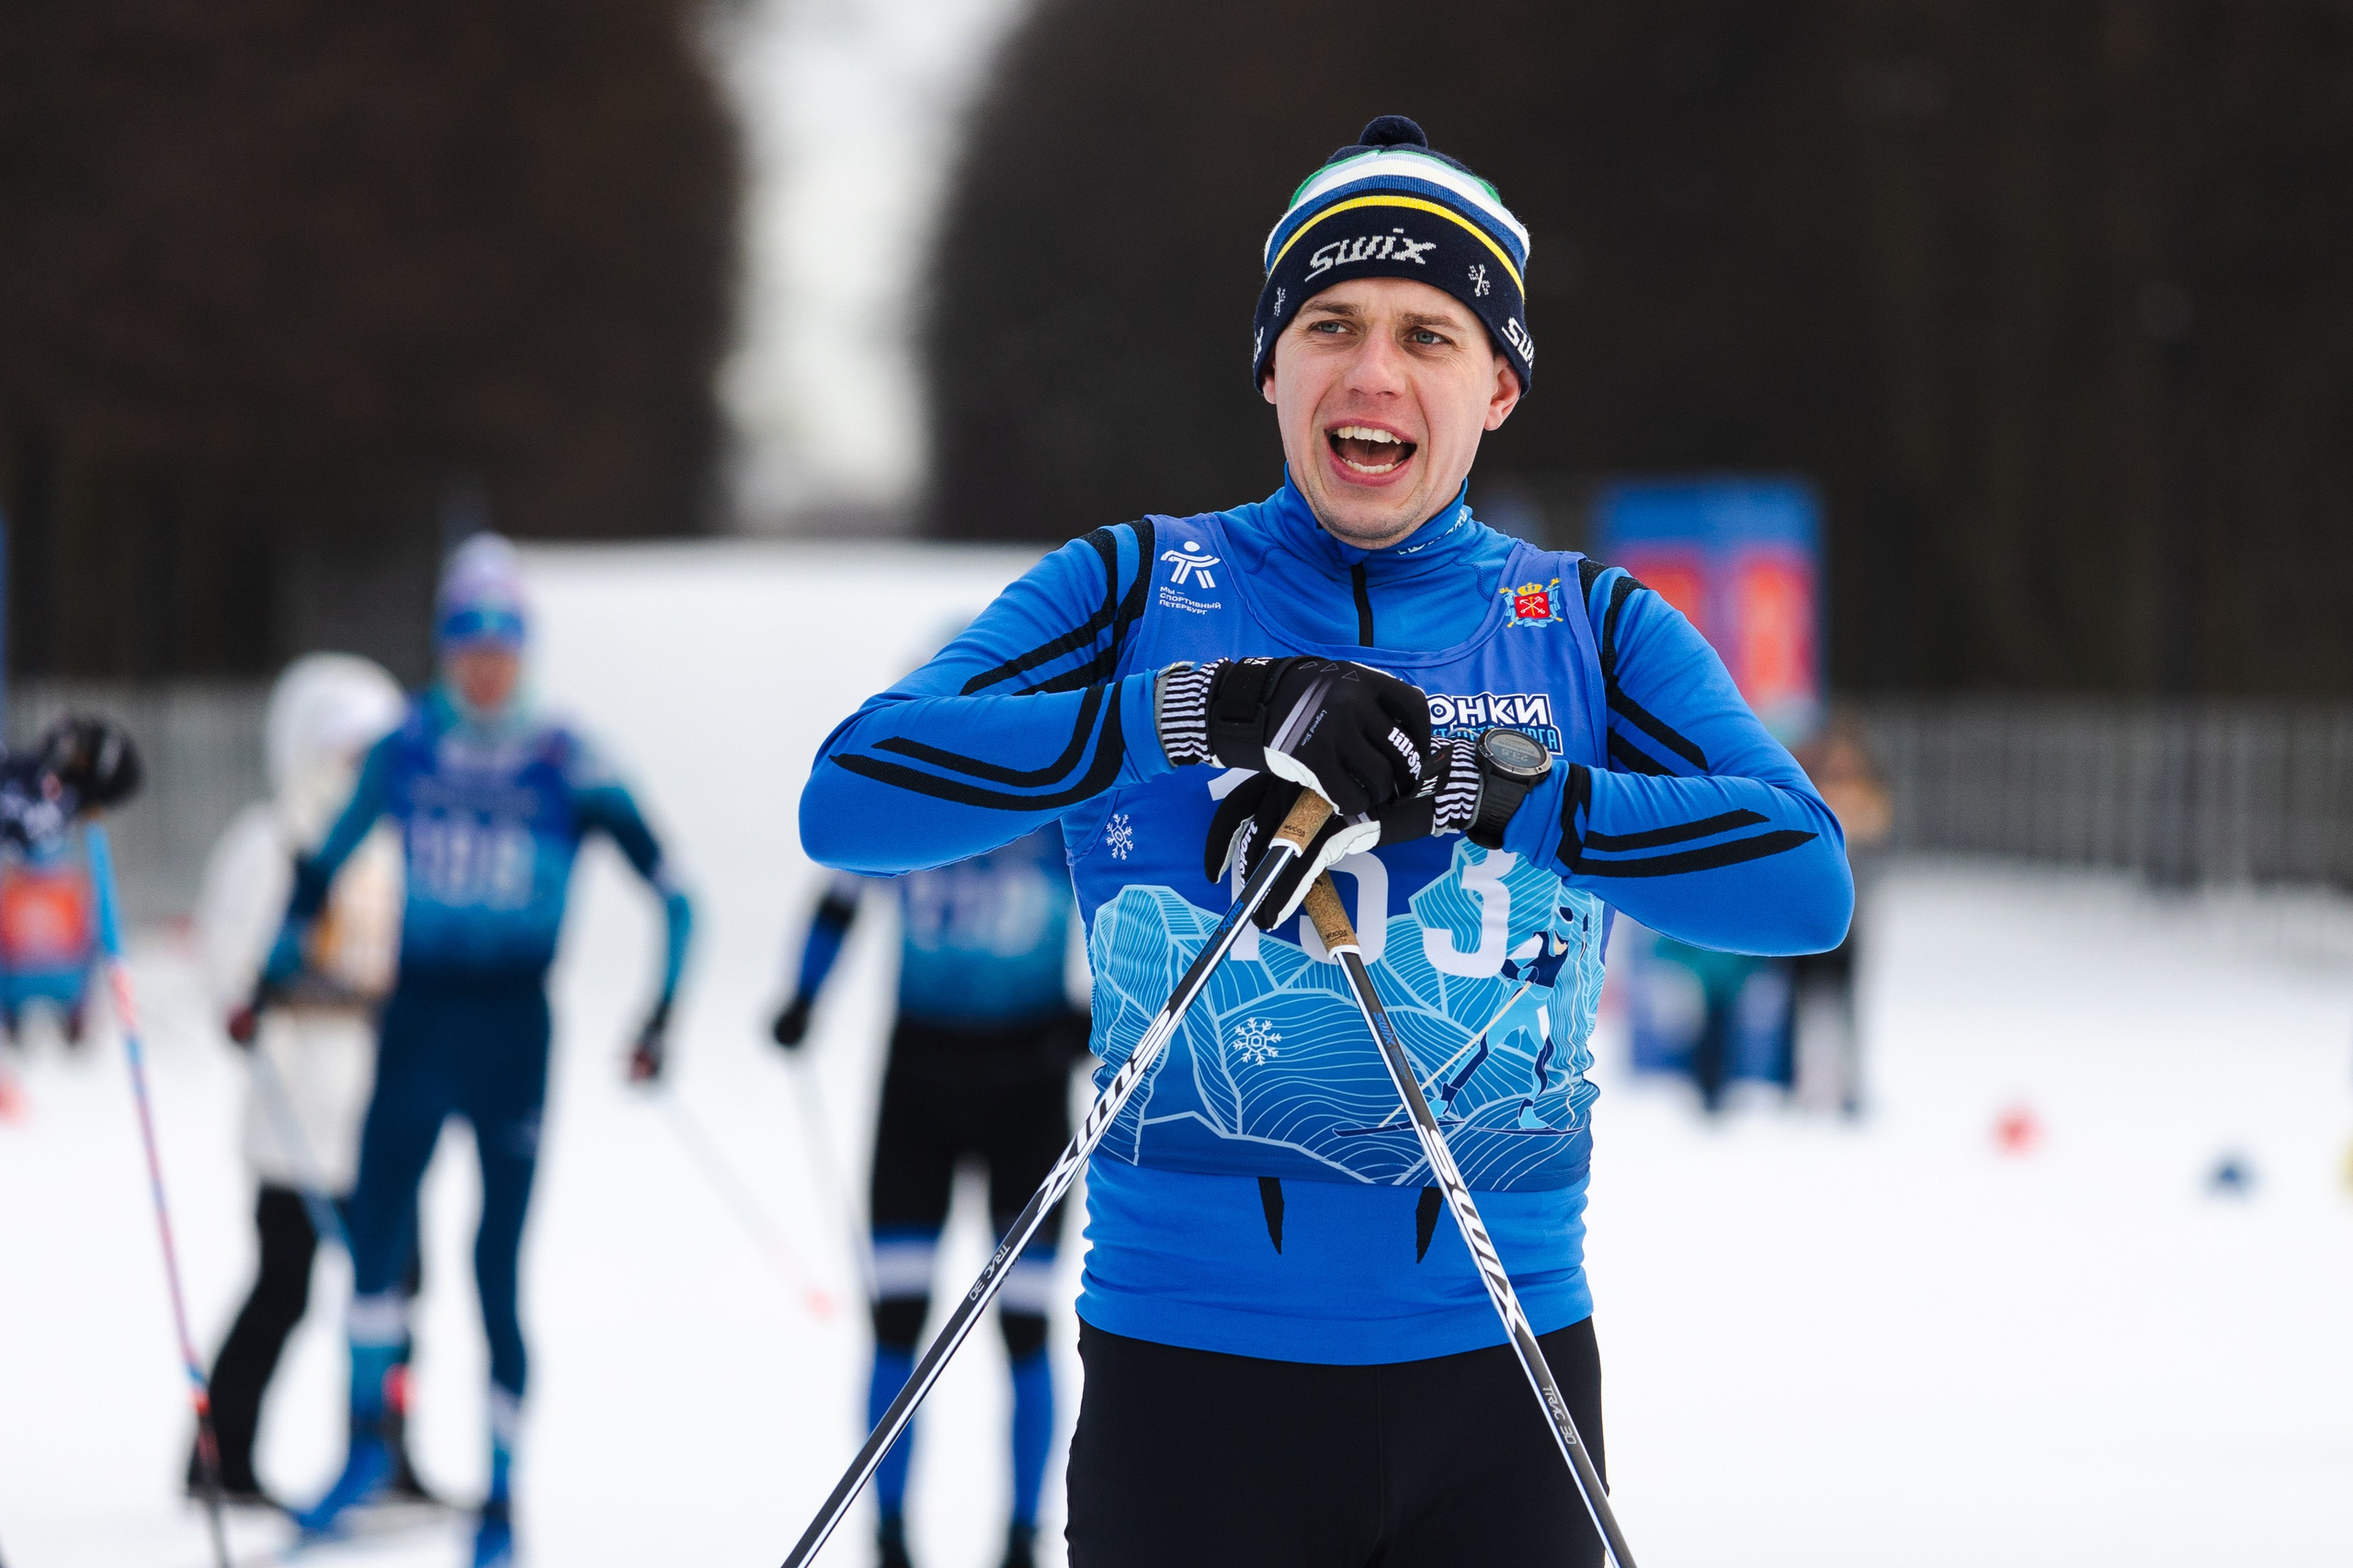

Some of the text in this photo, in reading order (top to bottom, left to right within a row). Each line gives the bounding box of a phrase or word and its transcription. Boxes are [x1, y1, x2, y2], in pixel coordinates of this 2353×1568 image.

[1158, 599, 1208, 615] ПЕТЕРБУРГ
[1159, 592, 1222, 609] СПОРТИВНЫЙ
[1427, 696, 1549, 725] ОНКИ
[1301, 709, 1328, 746] Legend Slim
